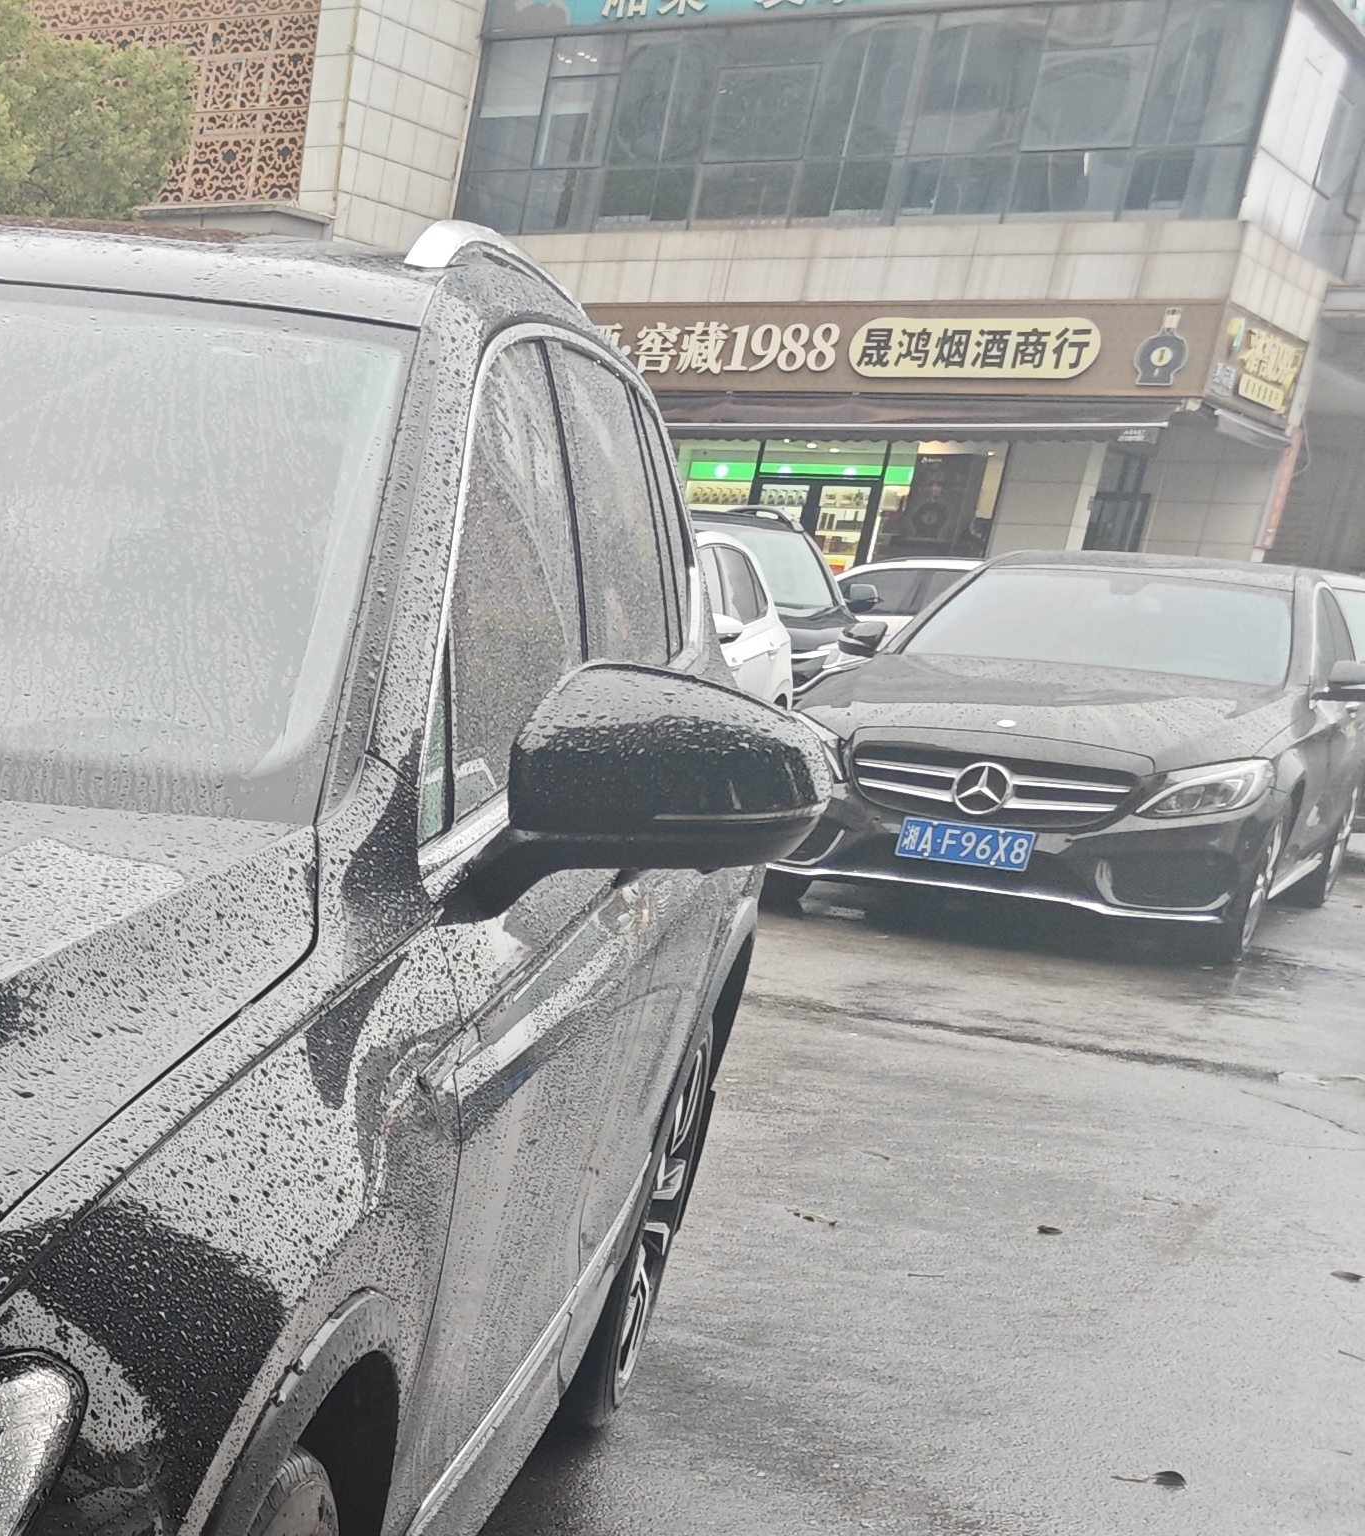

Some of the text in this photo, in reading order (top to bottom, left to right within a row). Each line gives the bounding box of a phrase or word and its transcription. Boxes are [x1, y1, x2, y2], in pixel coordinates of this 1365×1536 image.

[856, 327, 1093, 370] 晟鸿烟酒商行
[900, 824, 1029, 865] 湘A·F96X8
